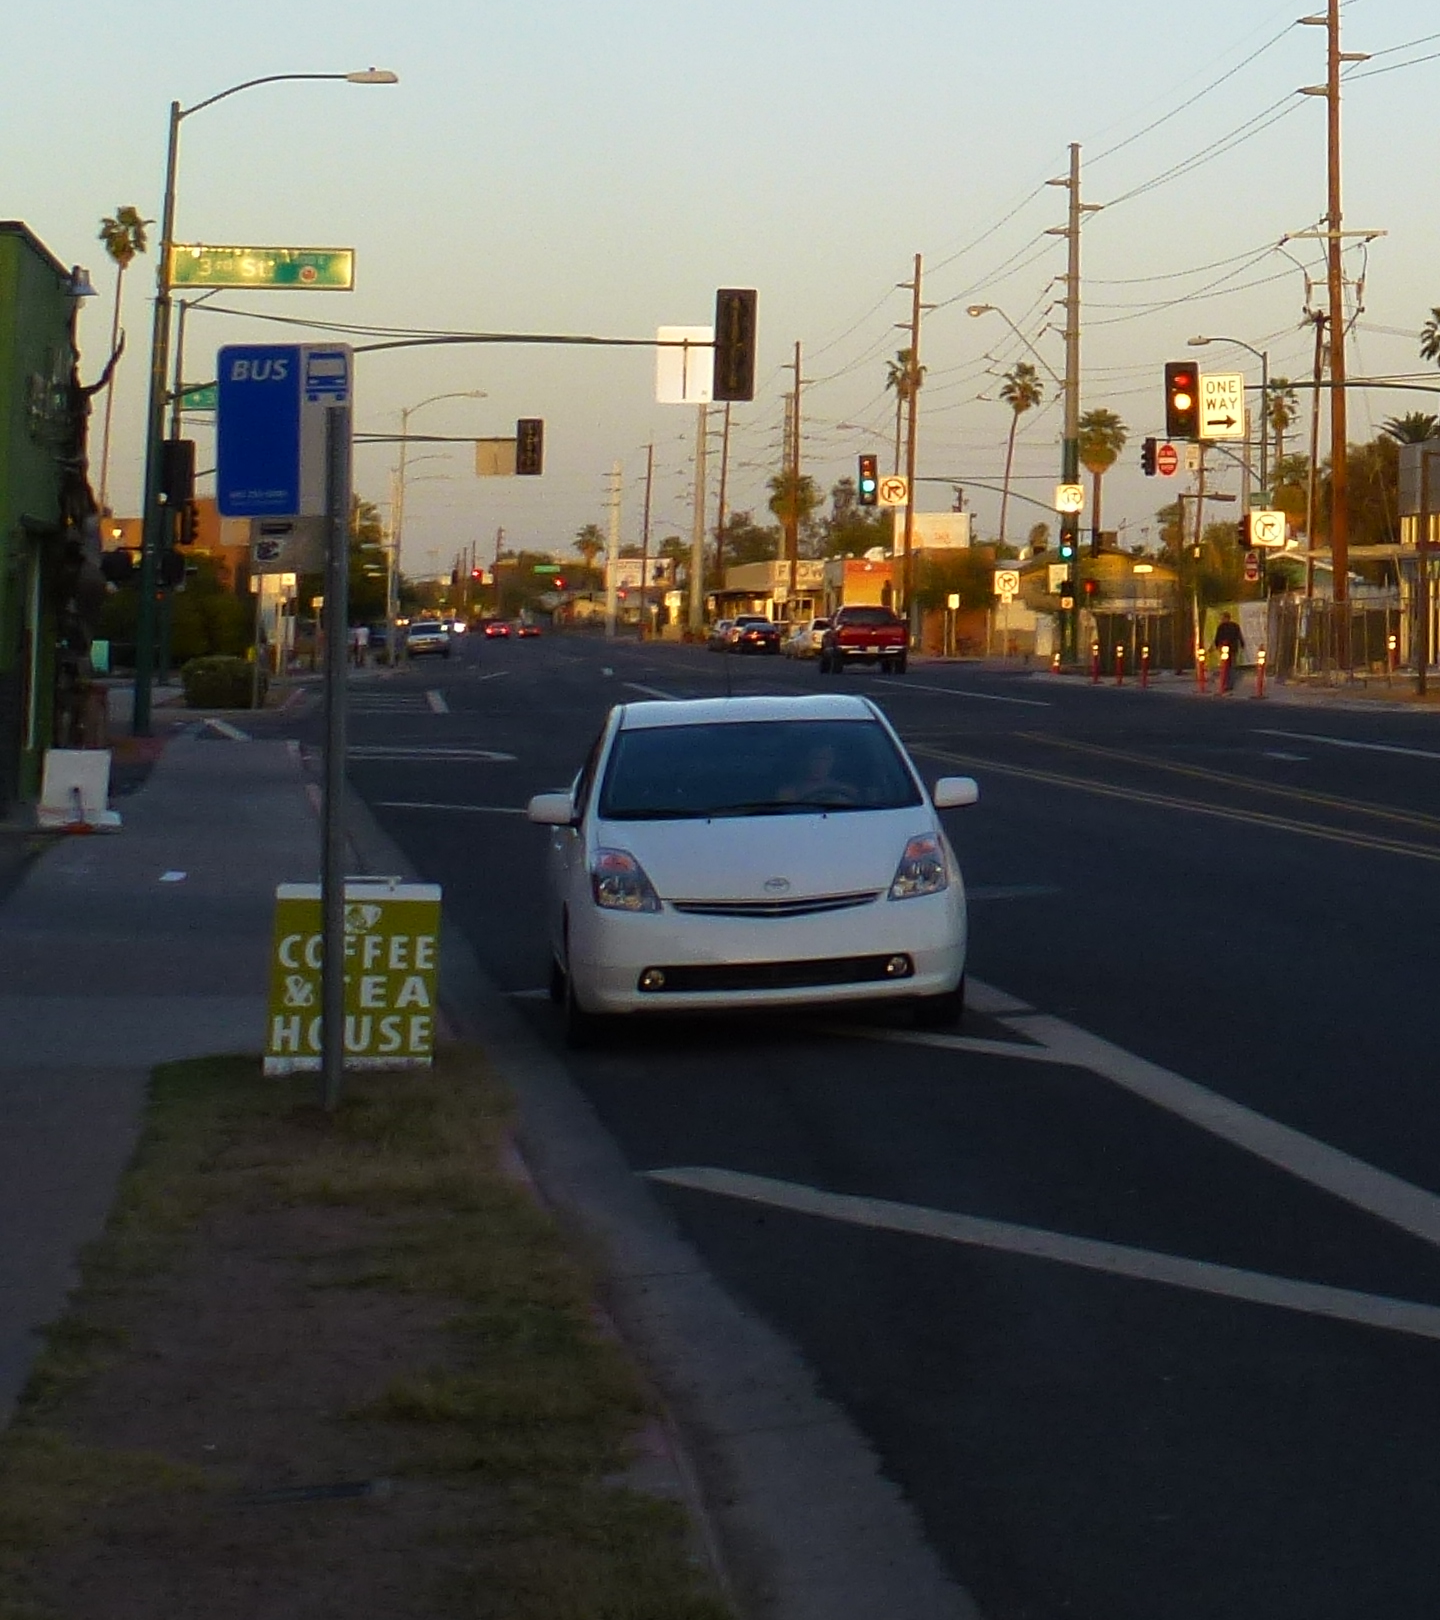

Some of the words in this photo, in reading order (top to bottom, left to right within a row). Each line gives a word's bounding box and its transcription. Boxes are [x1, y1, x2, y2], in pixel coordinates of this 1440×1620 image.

[199, 257, 234, 277] 3rd
[230, 359, 289, 381] BUS
[1206, 380, 1238, 395] ONE
[1206, 397, 1238, 411] WAY
[284, 975, 314, 1007] &
